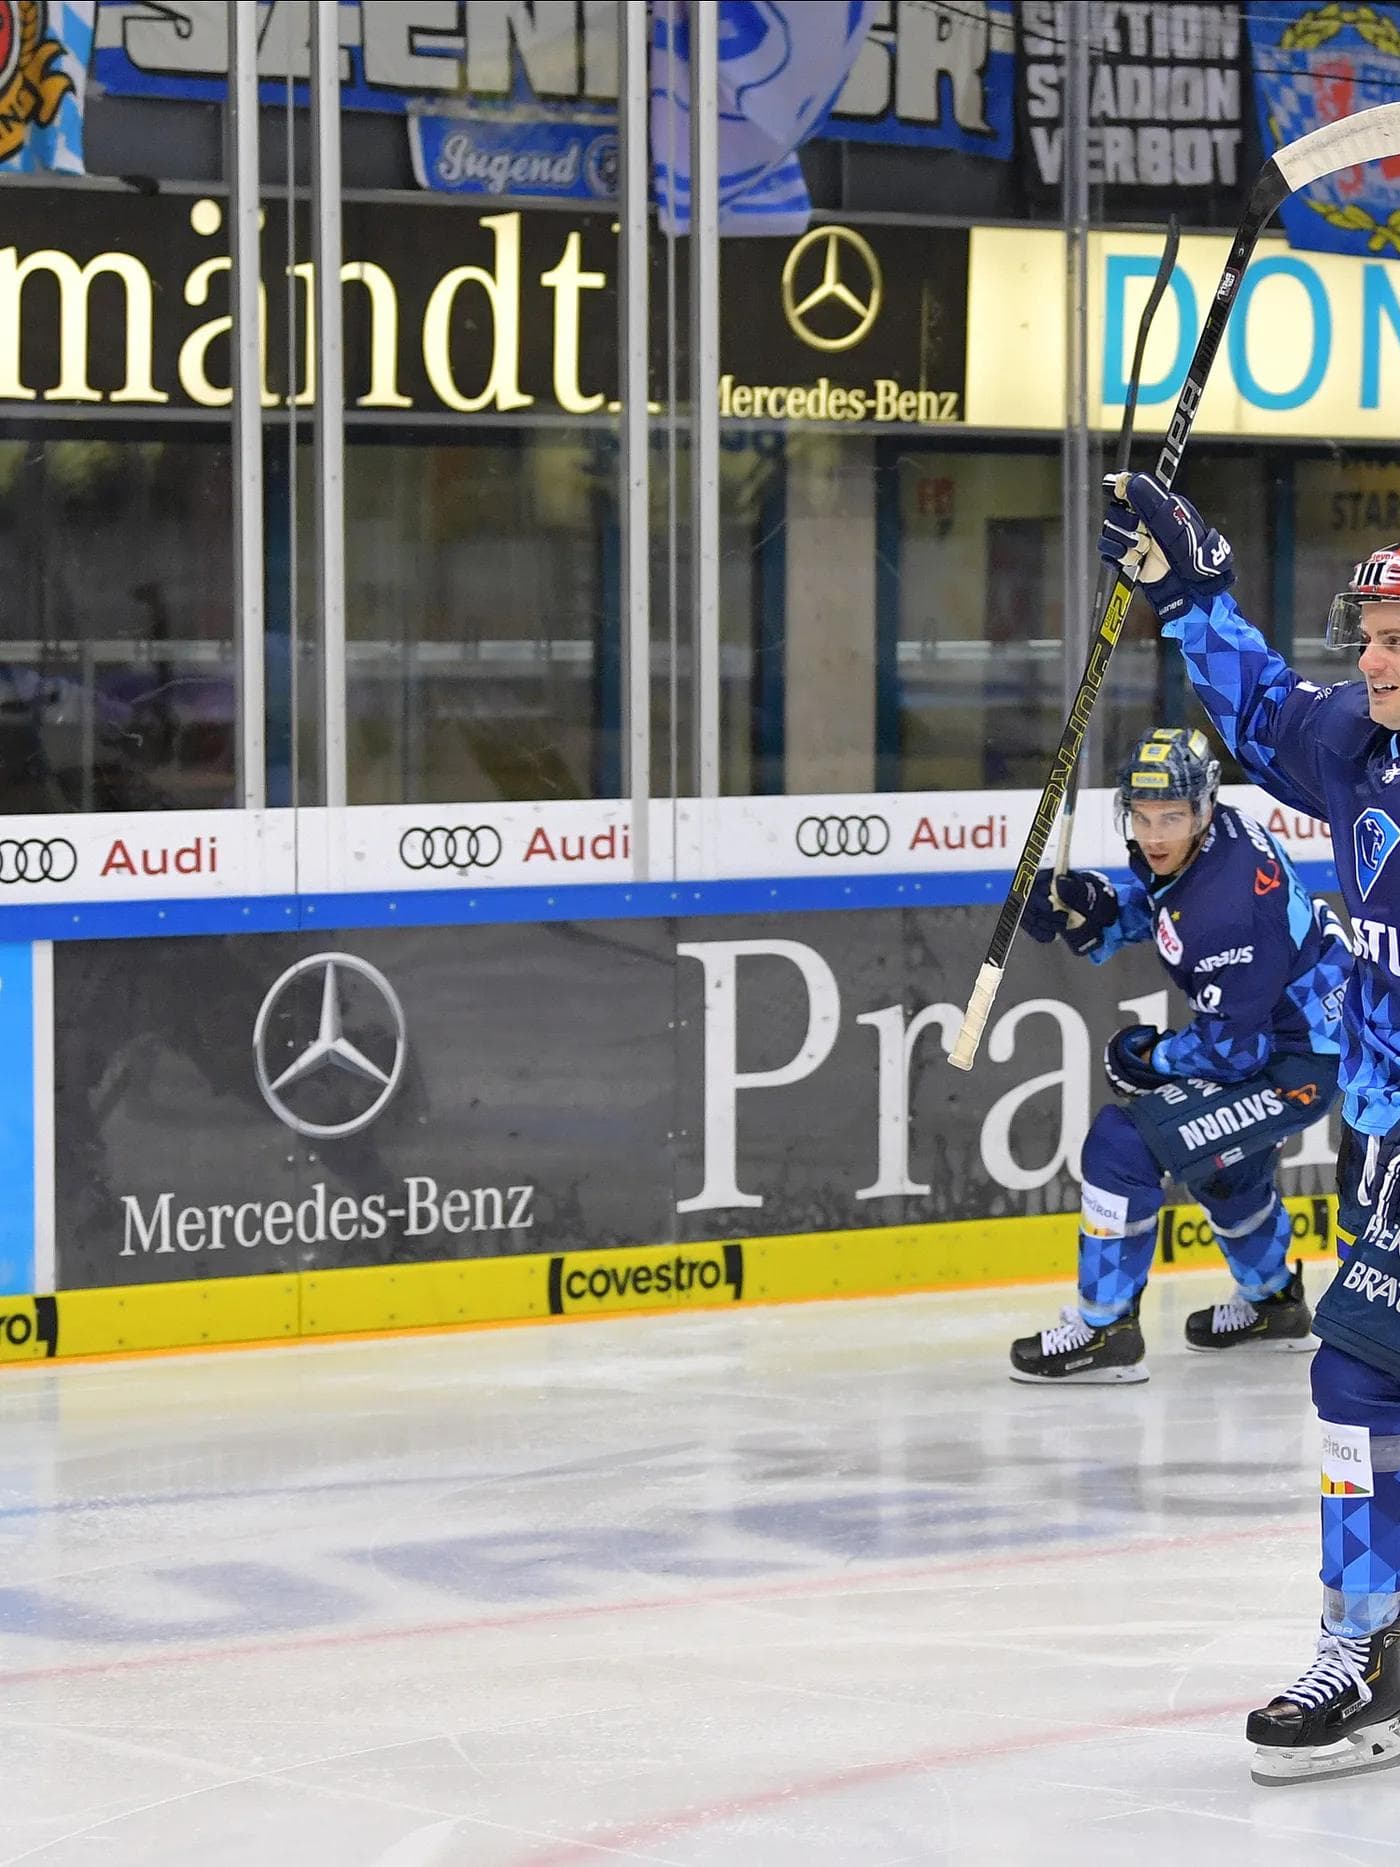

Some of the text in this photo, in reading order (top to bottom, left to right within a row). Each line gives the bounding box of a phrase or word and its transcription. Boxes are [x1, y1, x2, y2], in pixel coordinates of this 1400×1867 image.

[438, 132, 578, 193] Jugend
[523, 825, 632, 862] Audi
[909, 815, 1008, 850] Audi
[103, 837, 219, 876] Audi
[1177, 1087, 1285, 1151] SATURN
[119, 1176, 534, 1257] Mercedes-Benz
[565, 1258, 721, 1300] covestro
